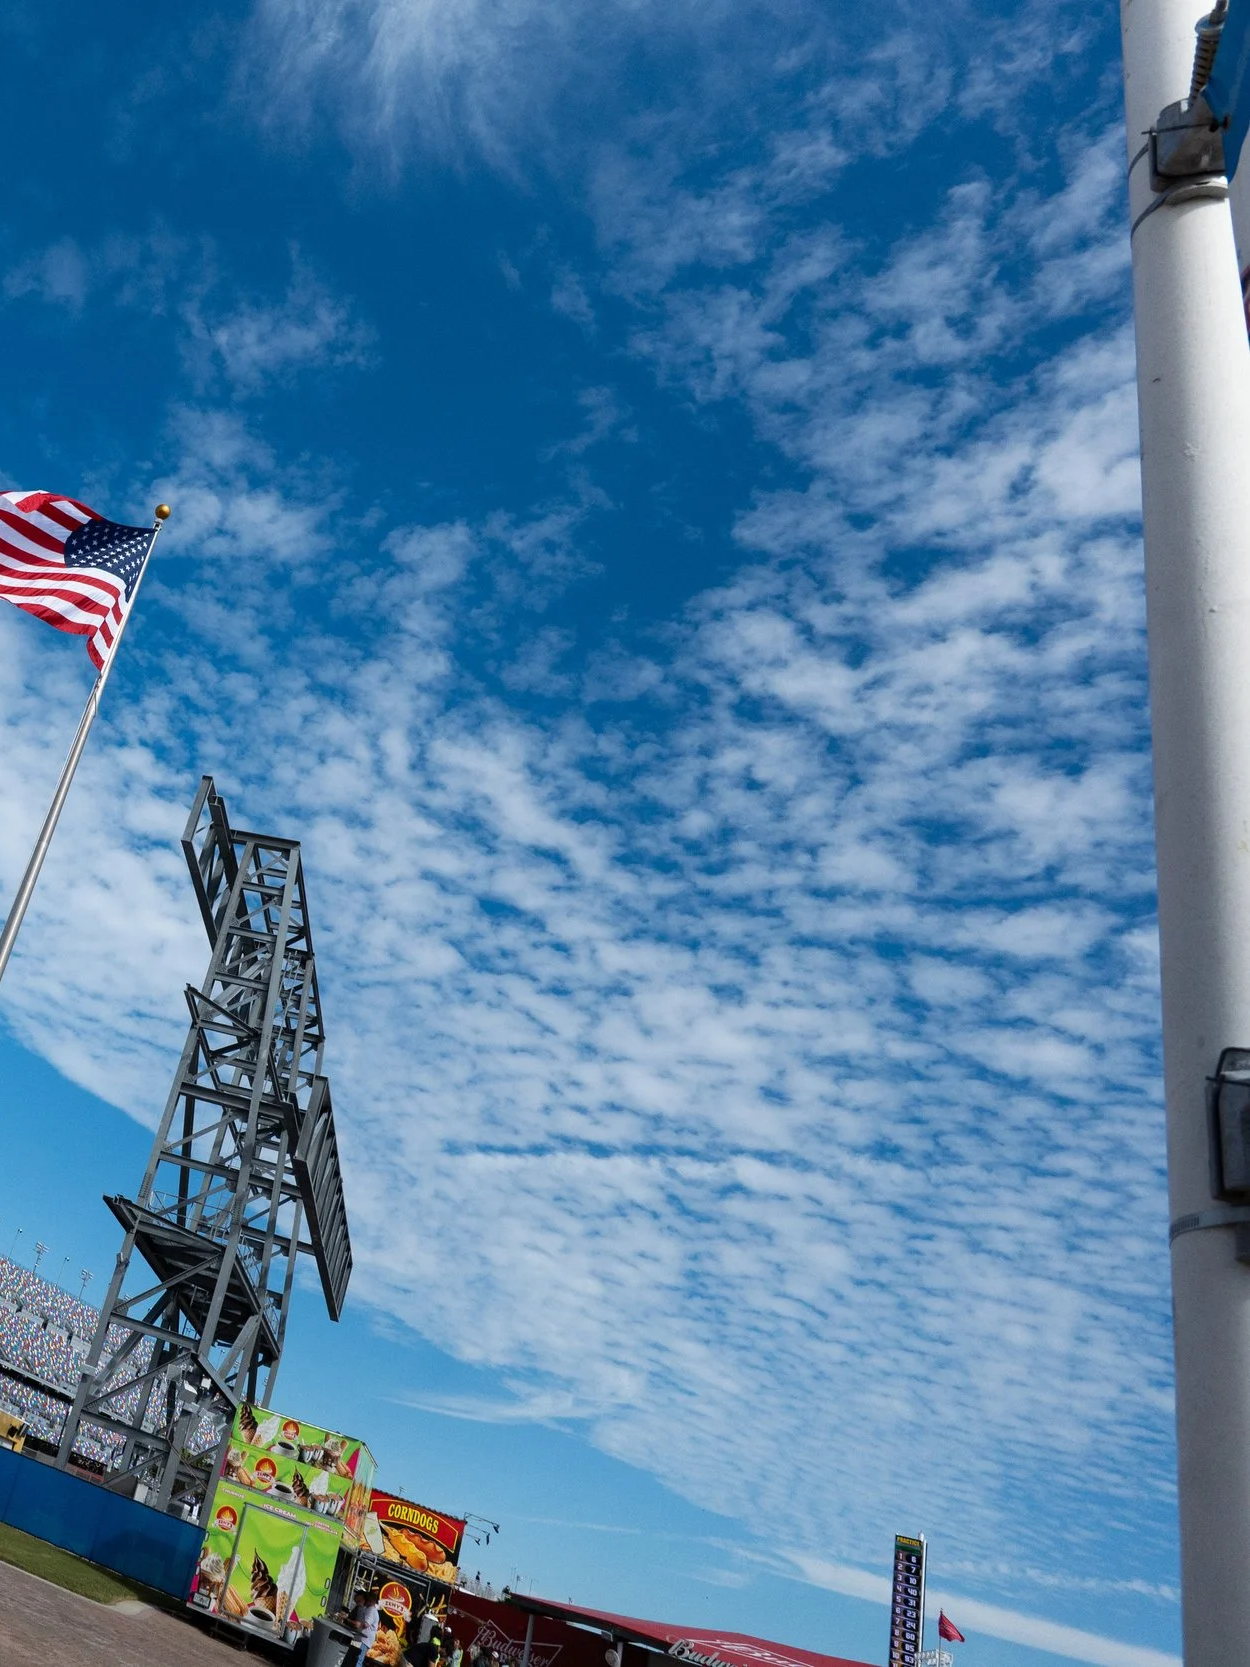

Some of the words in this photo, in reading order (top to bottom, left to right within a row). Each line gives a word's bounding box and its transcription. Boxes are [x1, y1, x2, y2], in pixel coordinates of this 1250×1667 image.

[273, 1507, 297, 1518] CREAM
[388, 1503, 439, 1533] CORNDOGS
[897, 1536, 920, 1547] PRACTICE
[909, 1577, 917, 1585] 10
[908, 1588, 917, 1596] 40
[908, 1599, 916, 1607] 31
[907, 1609, 916, 1618] 23
[906, 1621, 916, 1629] 24
[478, 1626, 550, 1667] Budweser
